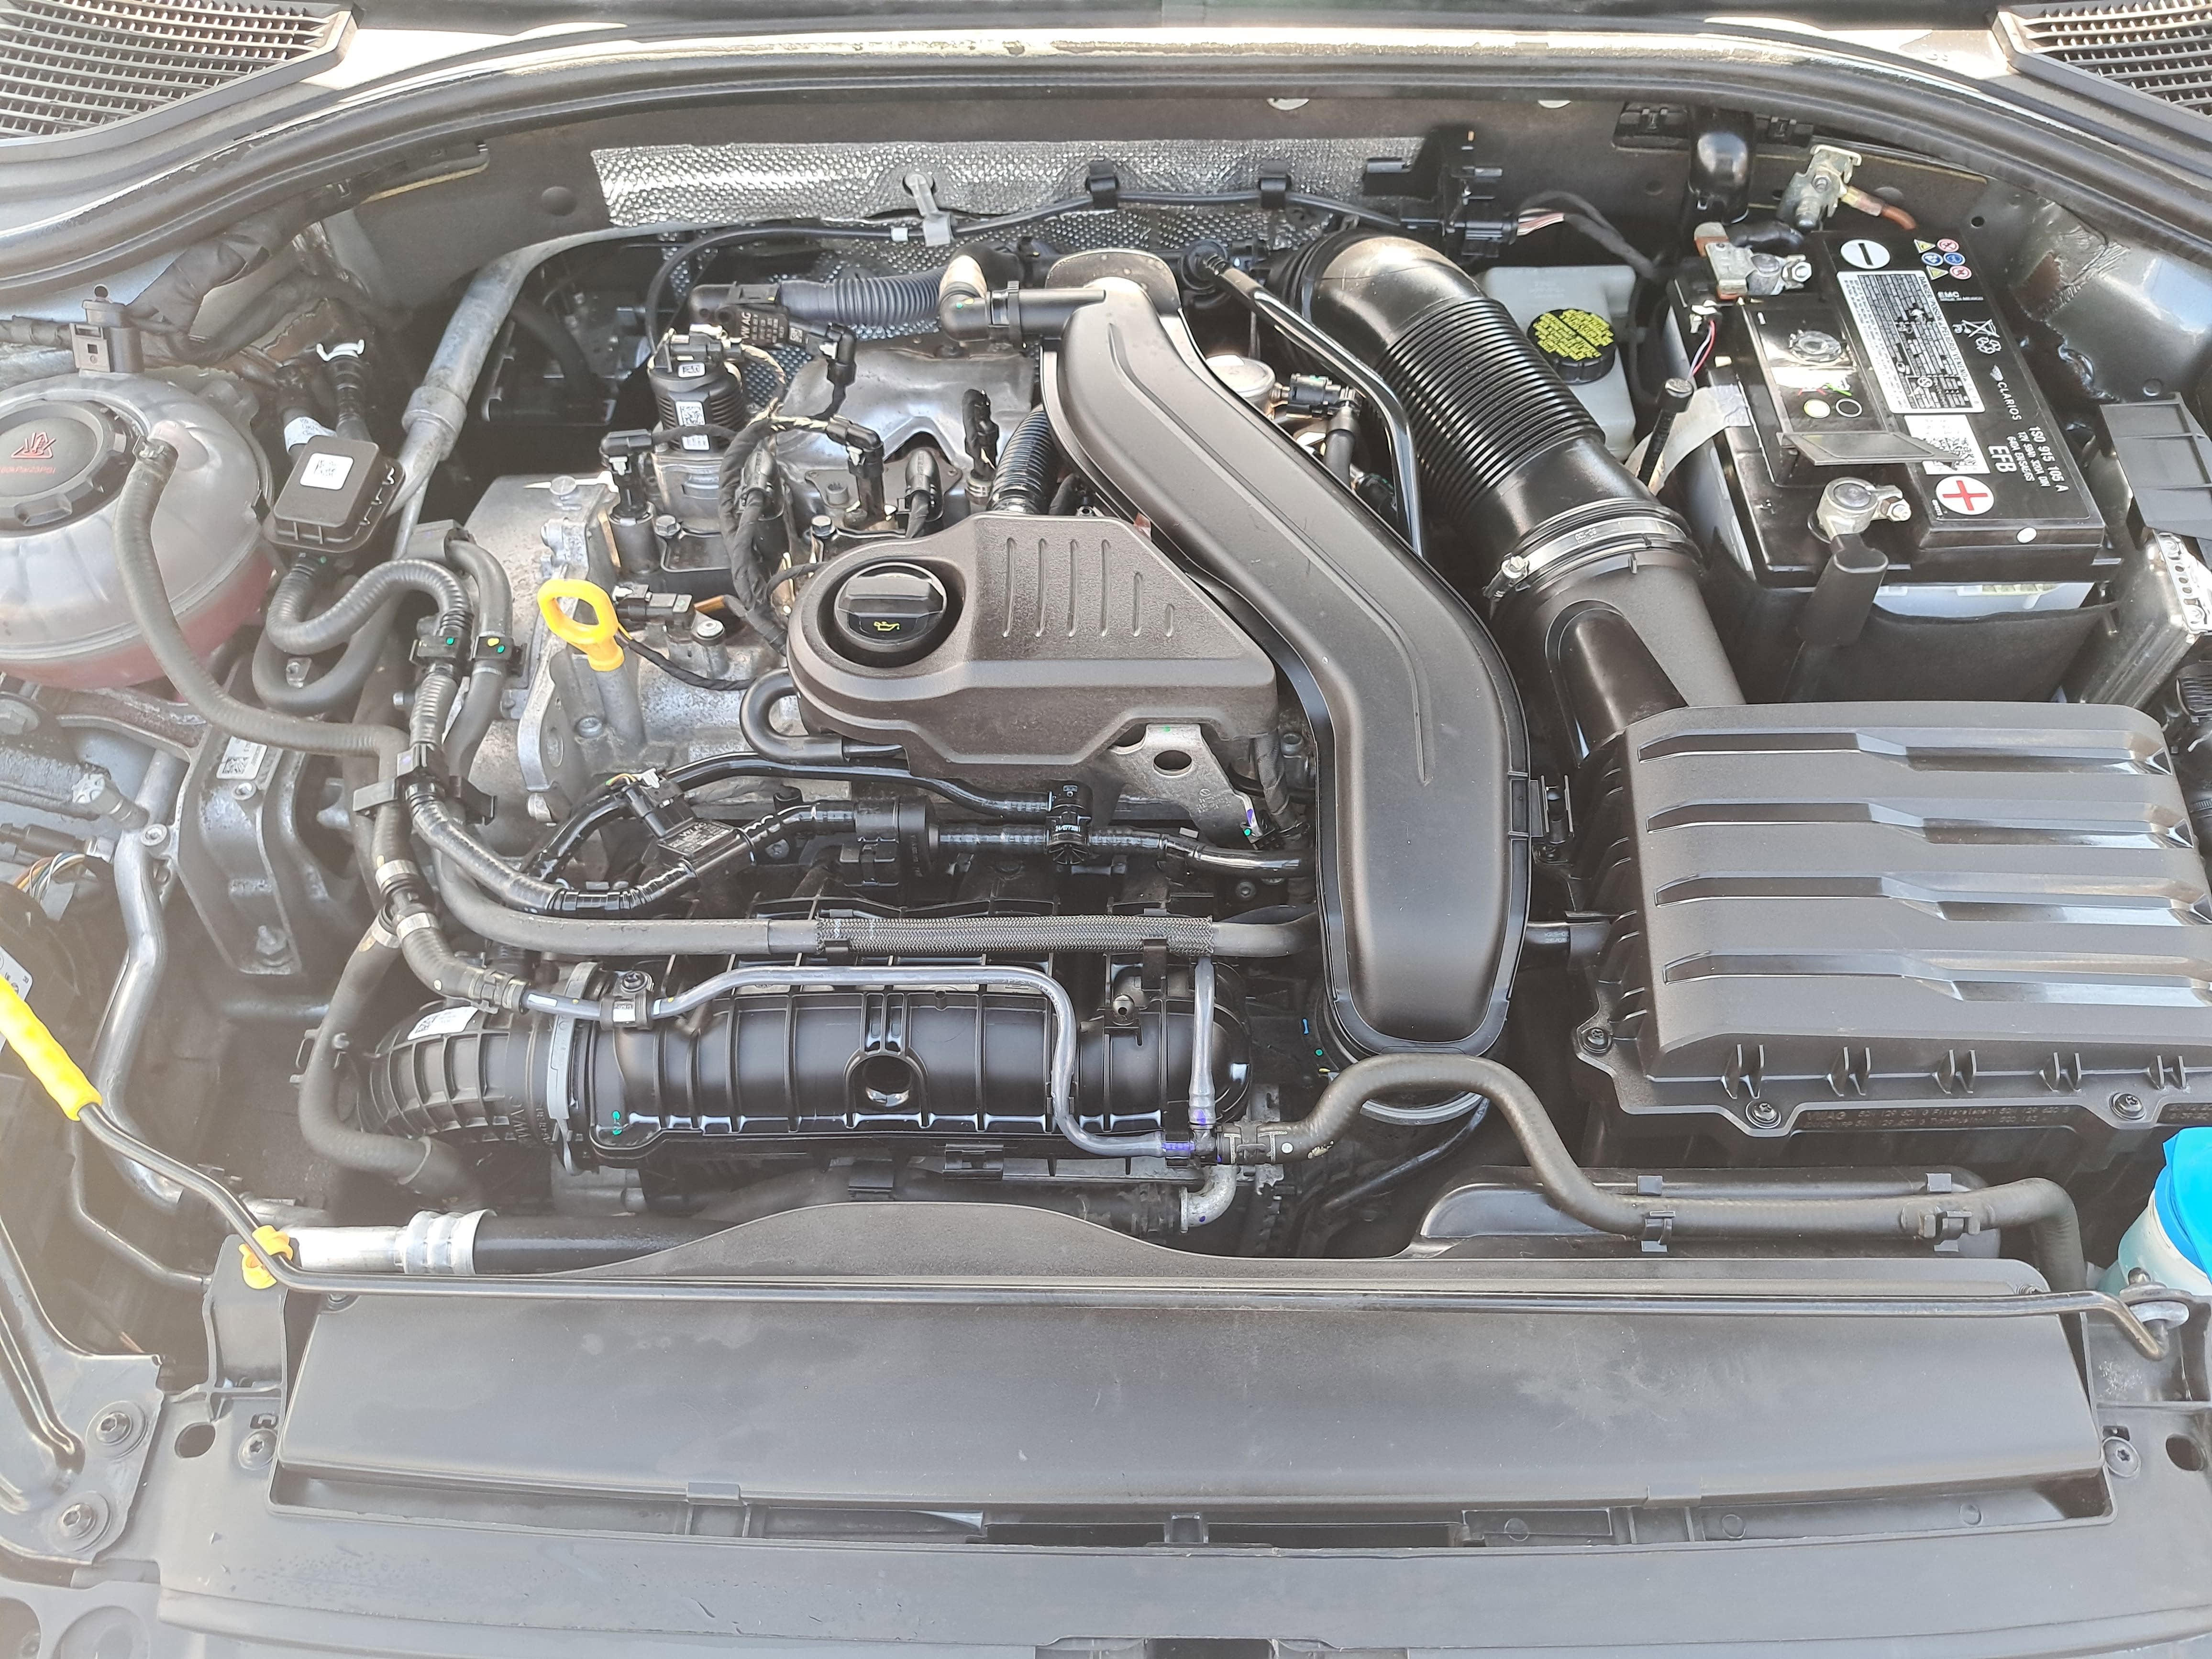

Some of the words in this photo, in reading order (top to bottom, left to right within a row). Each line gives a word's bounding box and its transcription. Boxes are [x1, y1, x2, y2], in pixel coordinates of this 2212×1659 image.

[741, 312, 752, 326] AG
[1997, 382, 2022, 420] CLARIOS
[1988, 445, 2017, 473] EFB
[2038, 445, 2056, 462] 915
[2047, 465, 2065, 482] 105
[2055, 484, 2069, 492] A
